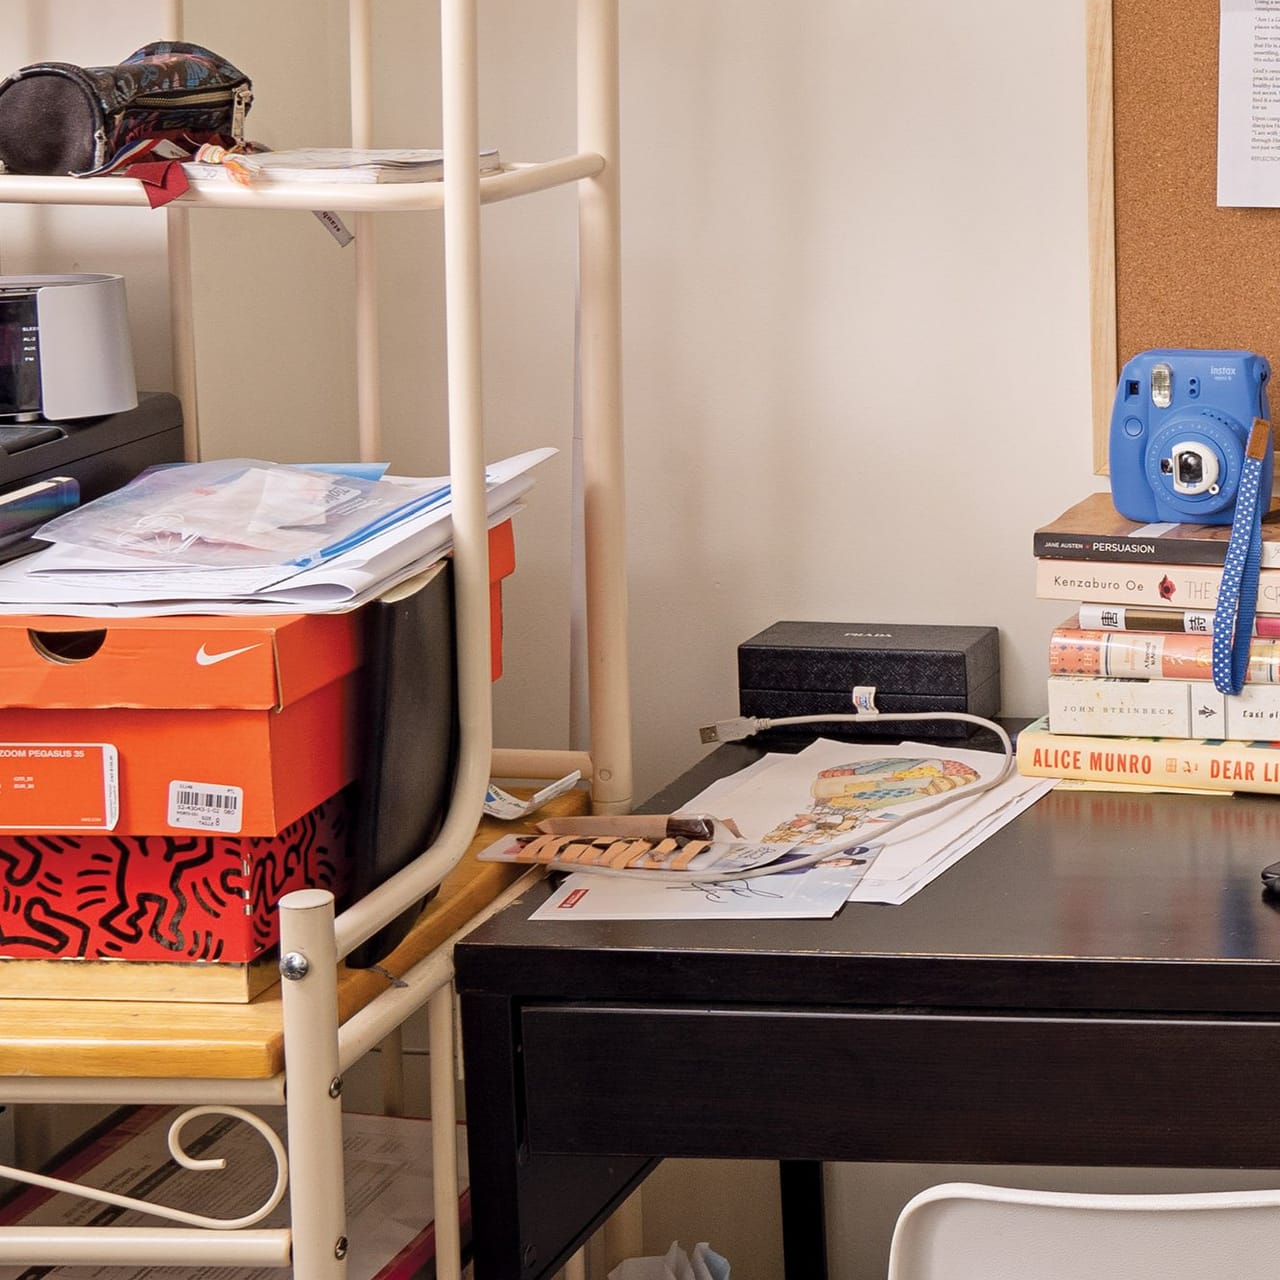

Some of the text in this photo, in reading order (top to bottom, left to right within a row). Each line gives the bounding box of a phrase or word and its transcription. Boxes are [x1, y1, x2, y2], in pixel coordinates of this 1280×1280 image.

[1210, 365, 1237, 375] instax
[1093, 542, 1155, 554] PERSUASION
[1054, 576, 1144, 592] Kenzaburo Oe
[1185, 580, 1212, 599] THE
[1103, 707, 1174, 715] STEINBECK
[1242, 710, 1263, 718] East
[1269, 710, 1279, 719] of
[0, 750, 85, 758] ZOOM PEGASUS 35
[1033, 748, 1082, 770] ALICE
[1090, 752, 1152, 775] MUNRO
[1210, 759, 1255, 781] DEAR
